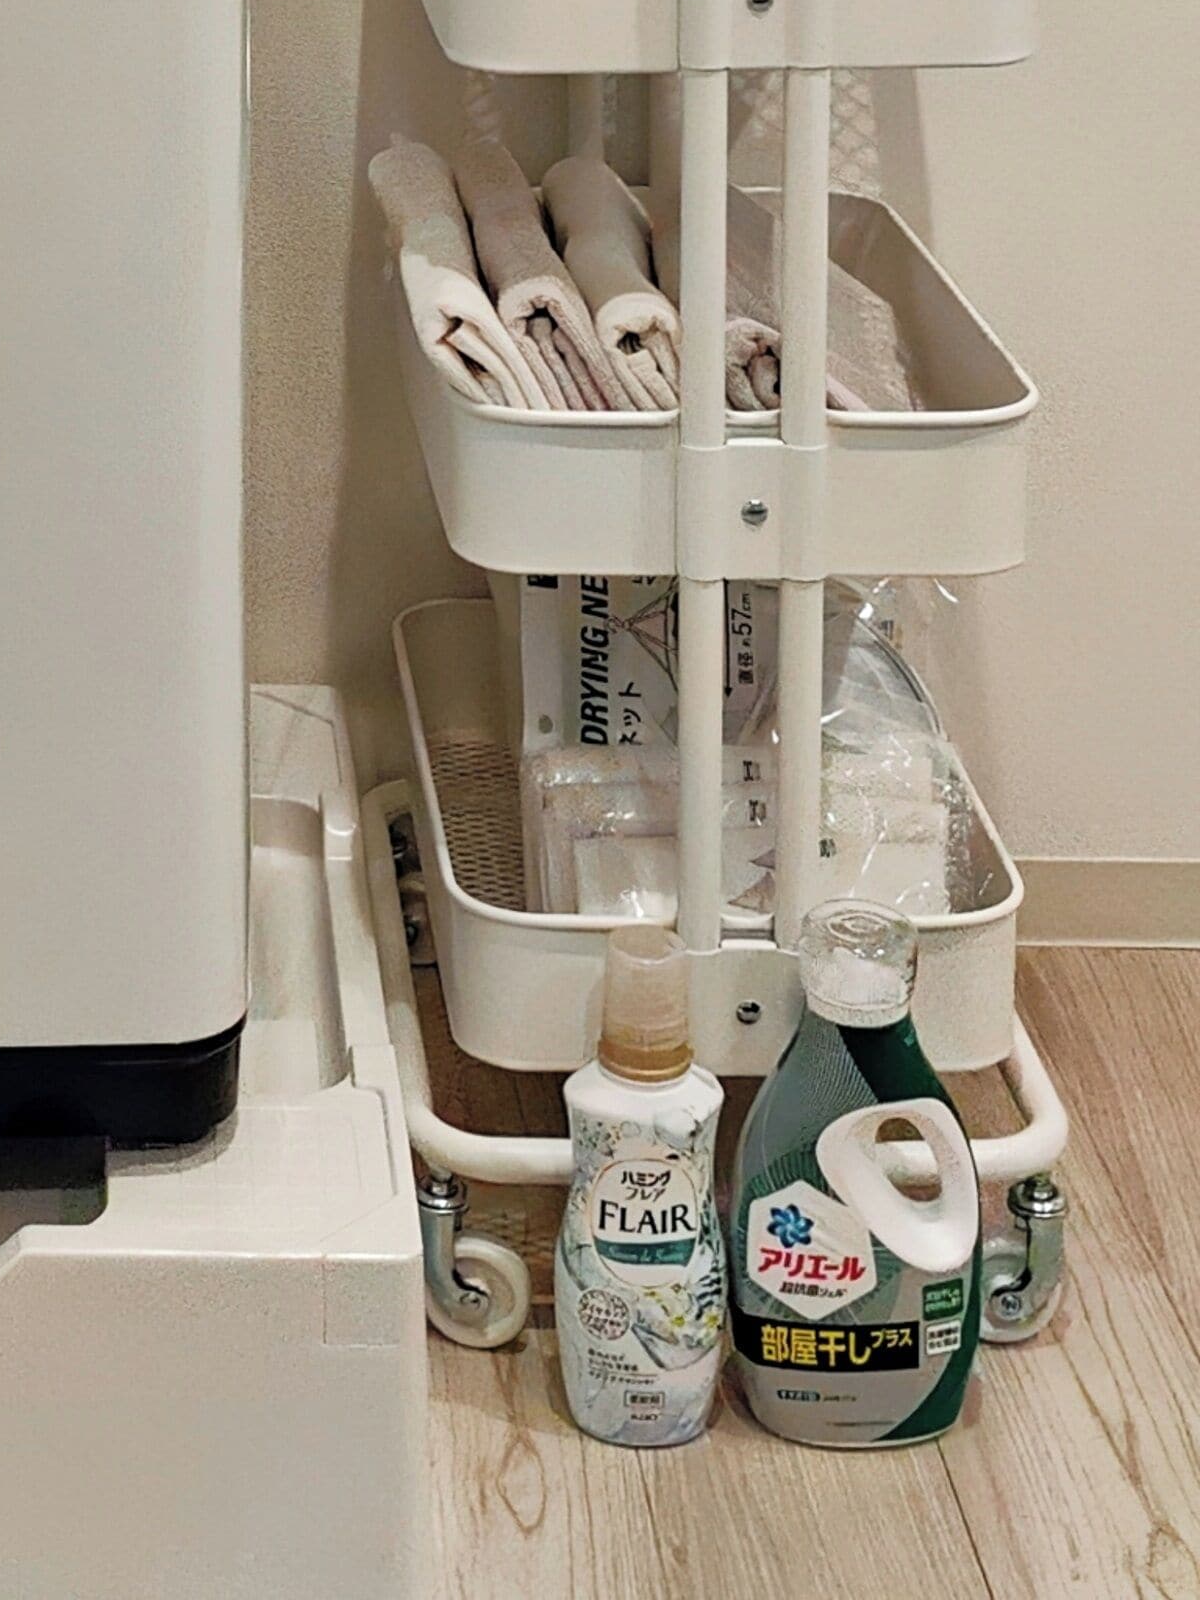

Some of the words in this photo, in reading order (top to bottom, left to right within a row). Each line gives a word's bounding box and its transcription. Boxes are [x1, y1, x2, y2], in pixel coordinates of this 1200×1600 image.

[580, 625, 609, 745] DRYING
[620, 1169, 672, 1188] ハミング
[625, 1186, 667, 1202] フレア
[598, 1199, 697, 1235] FLAIR
[757, 1247, 866, 1281] アリエール
[760, 1324, 913, 1368] 部屋干しプラス
